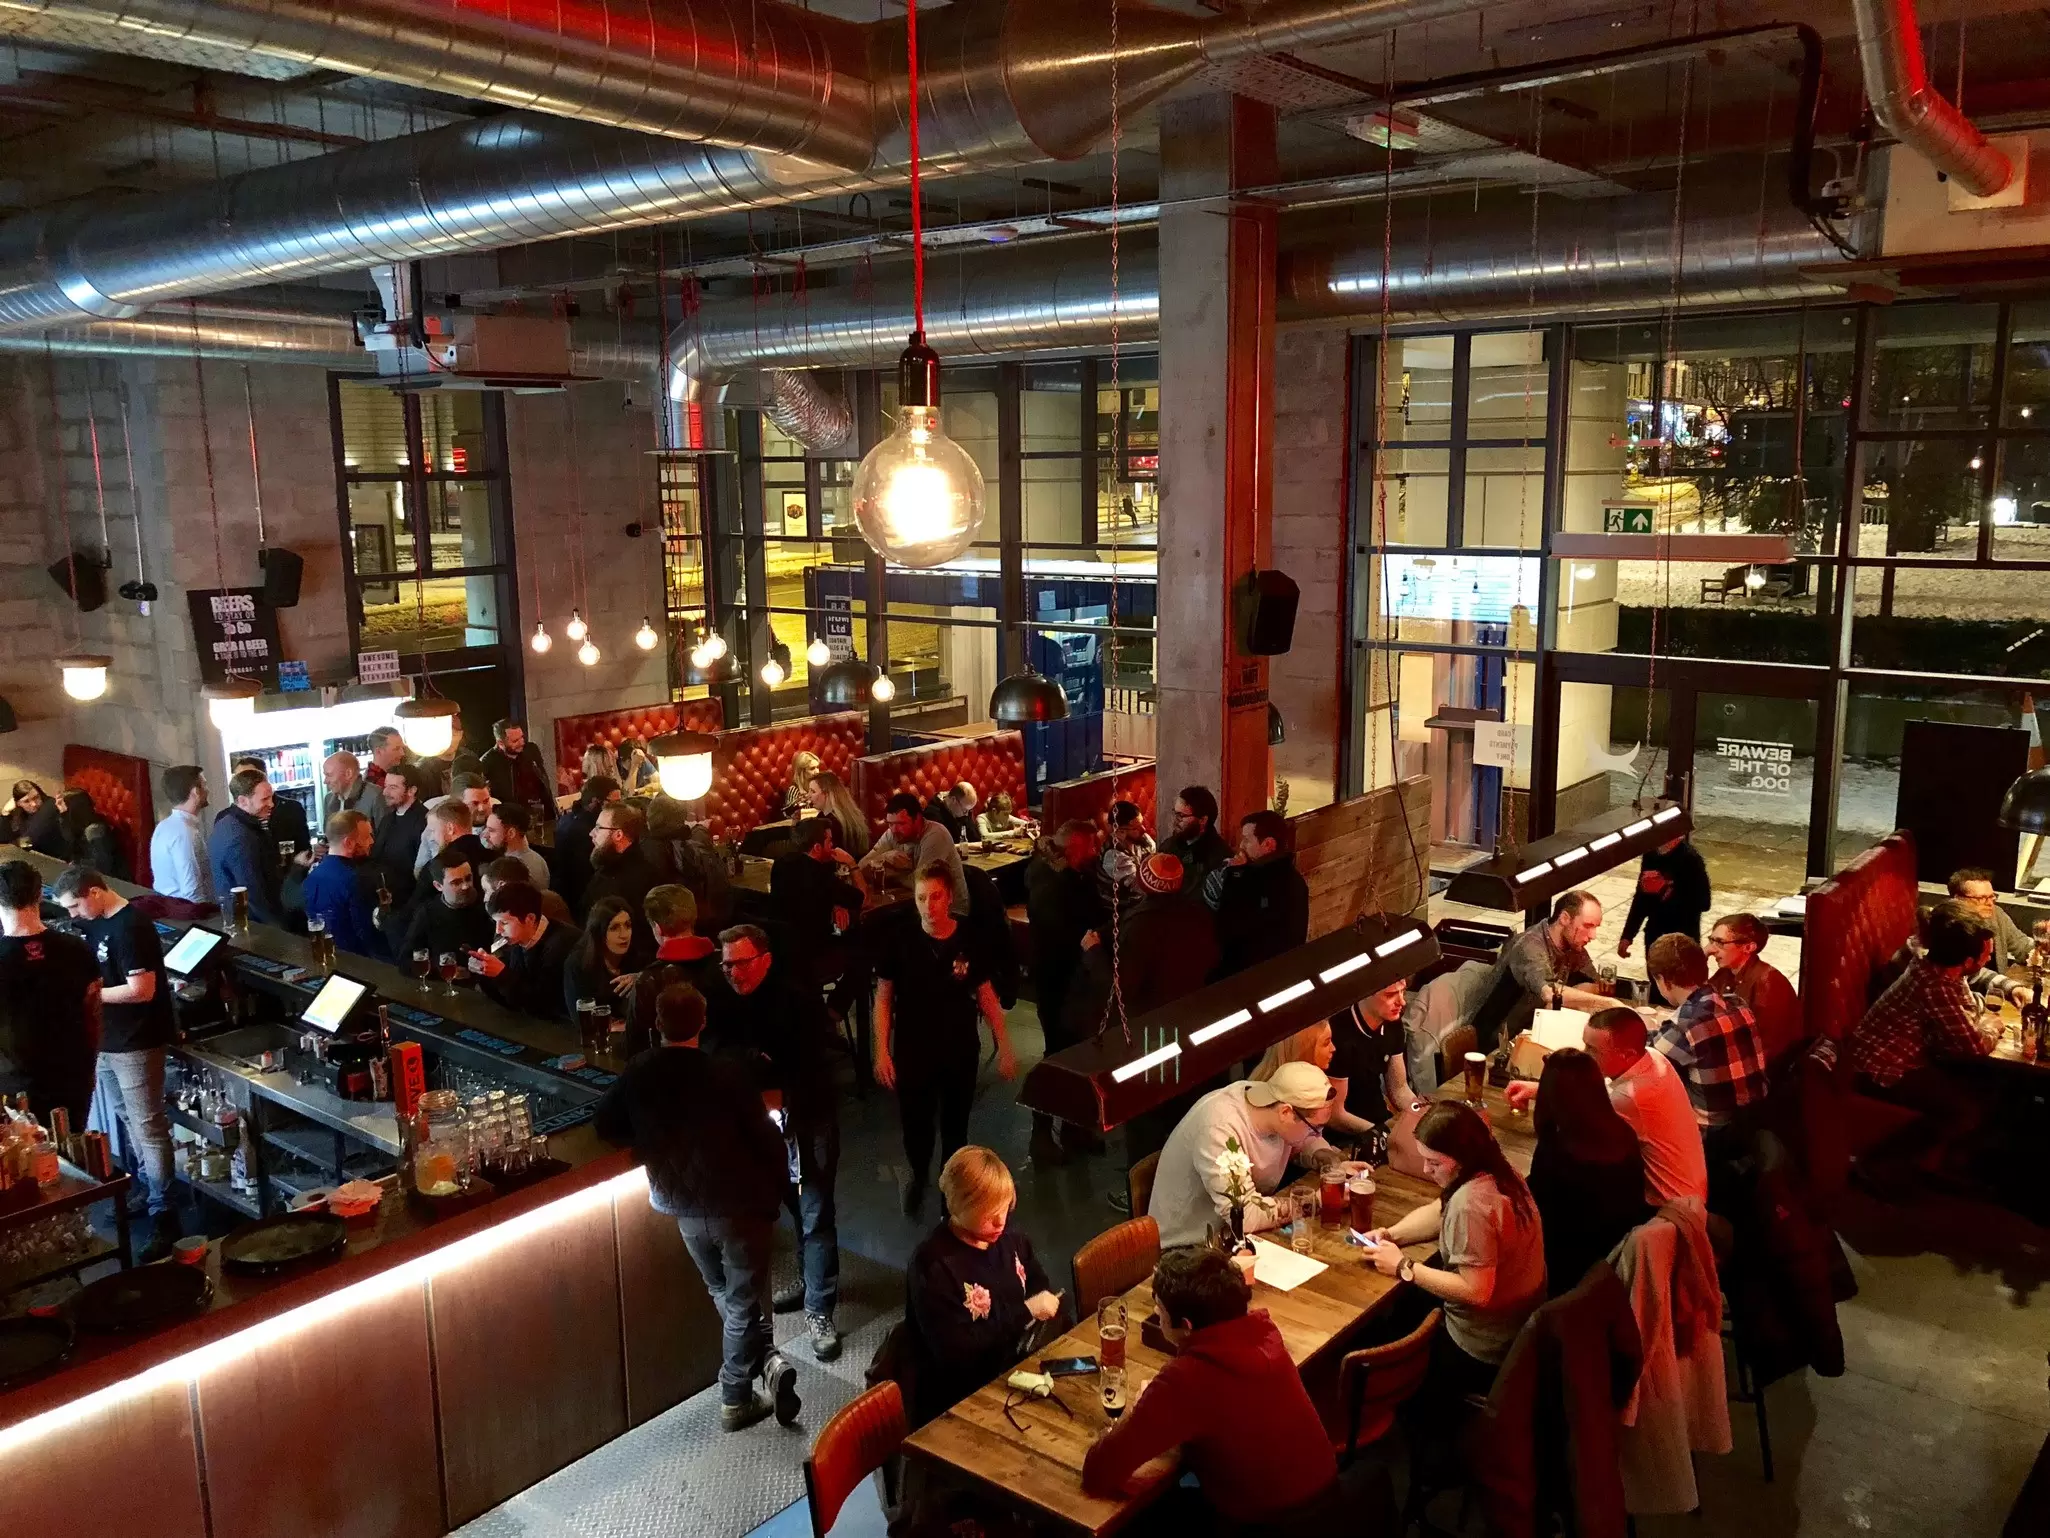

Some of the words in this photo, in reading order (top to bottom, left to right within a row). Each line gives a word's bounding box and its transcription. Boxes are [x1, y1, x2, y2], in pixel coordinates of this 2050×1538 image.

[210, 595, 255, 613] BEERS
[831, 624, 846, 633] Ltd
[213, 641, 238, 652] GRAB
[238, 641, 245, 650] A
[245, 639, 268, 650] BEER
[363, 653, 394, 661] AWESOME
